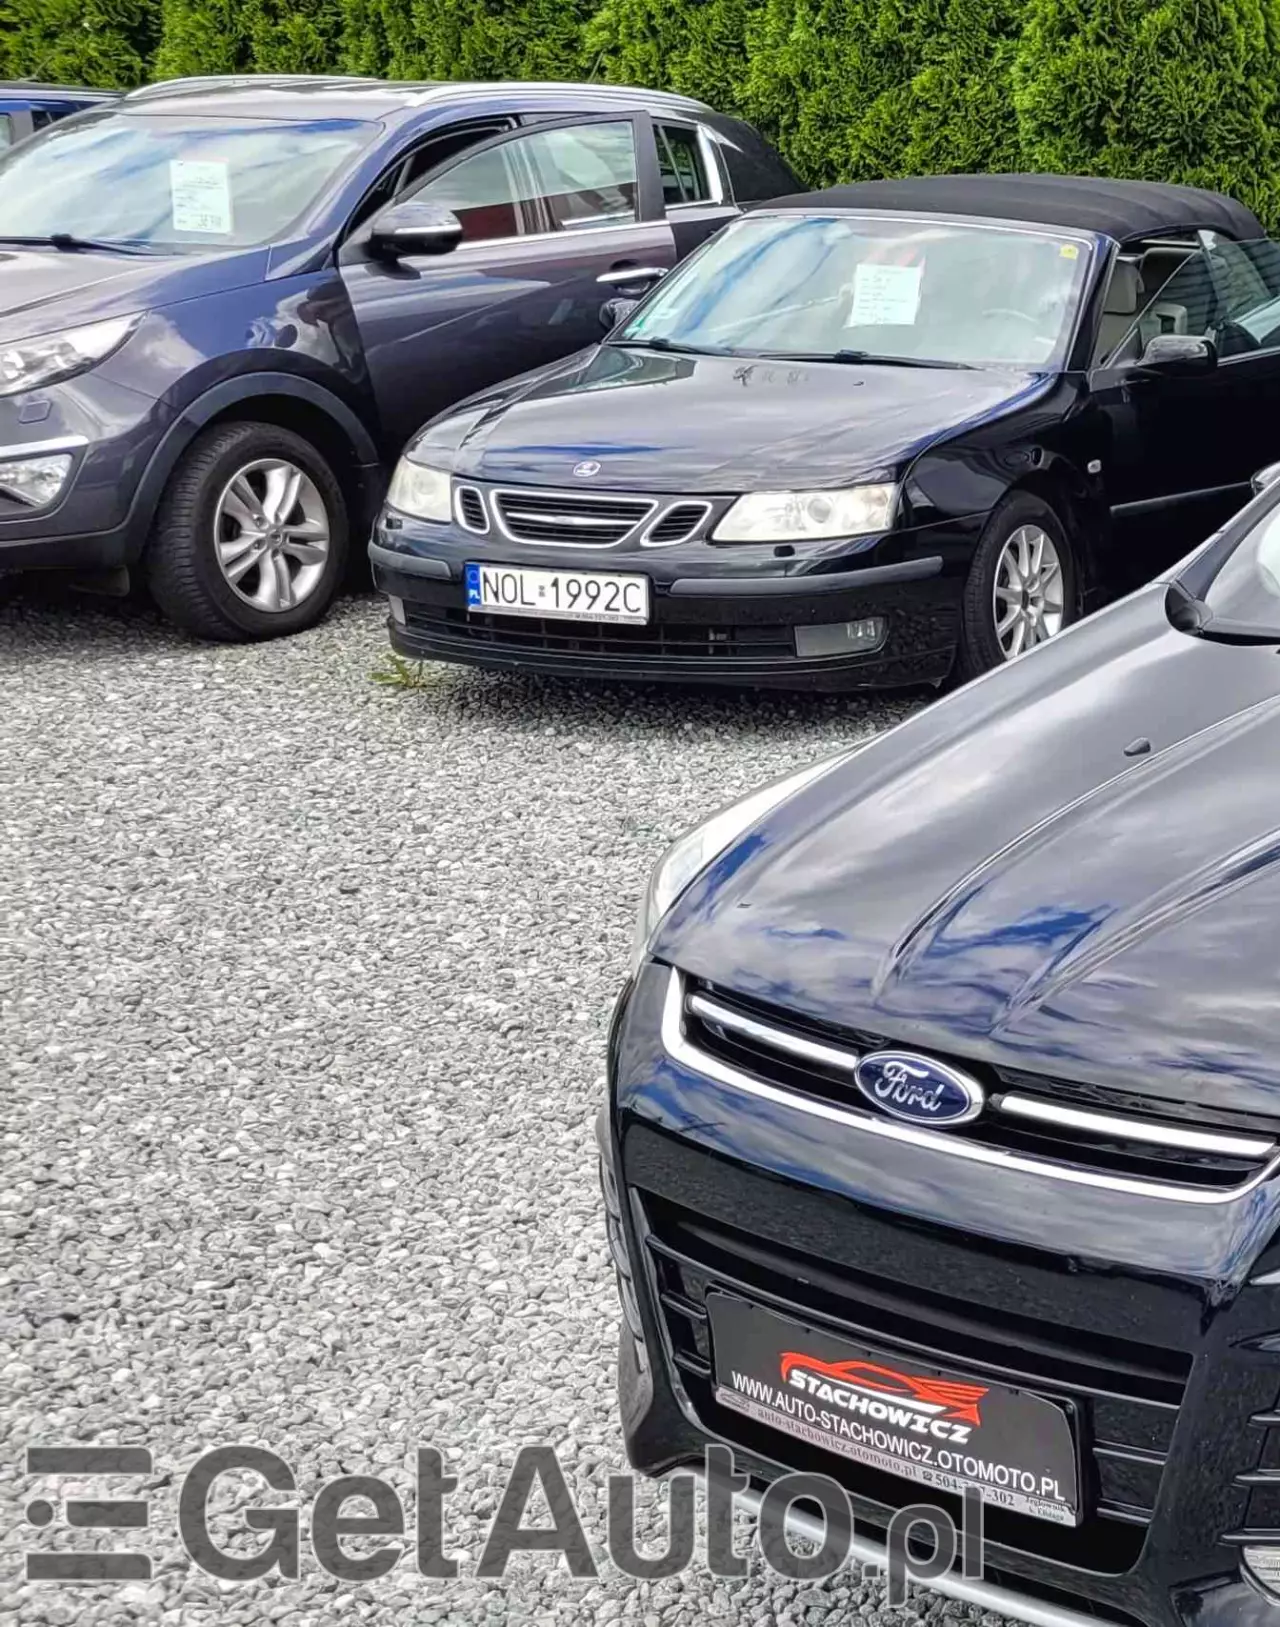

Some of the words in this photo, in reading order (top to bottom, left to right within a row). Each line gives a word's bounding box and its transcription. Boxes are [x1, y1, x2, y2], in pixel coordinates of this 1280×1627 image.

[550, 577, 642, 614] 1992C
[874, 1061, 945, 1112] Ford
[731, 1371, 1066, 1501] WWW.AUTO-STACHOWICZ.OTOMOTO.PL
[789, 1368, 973, 1445] STACHOWICZ
